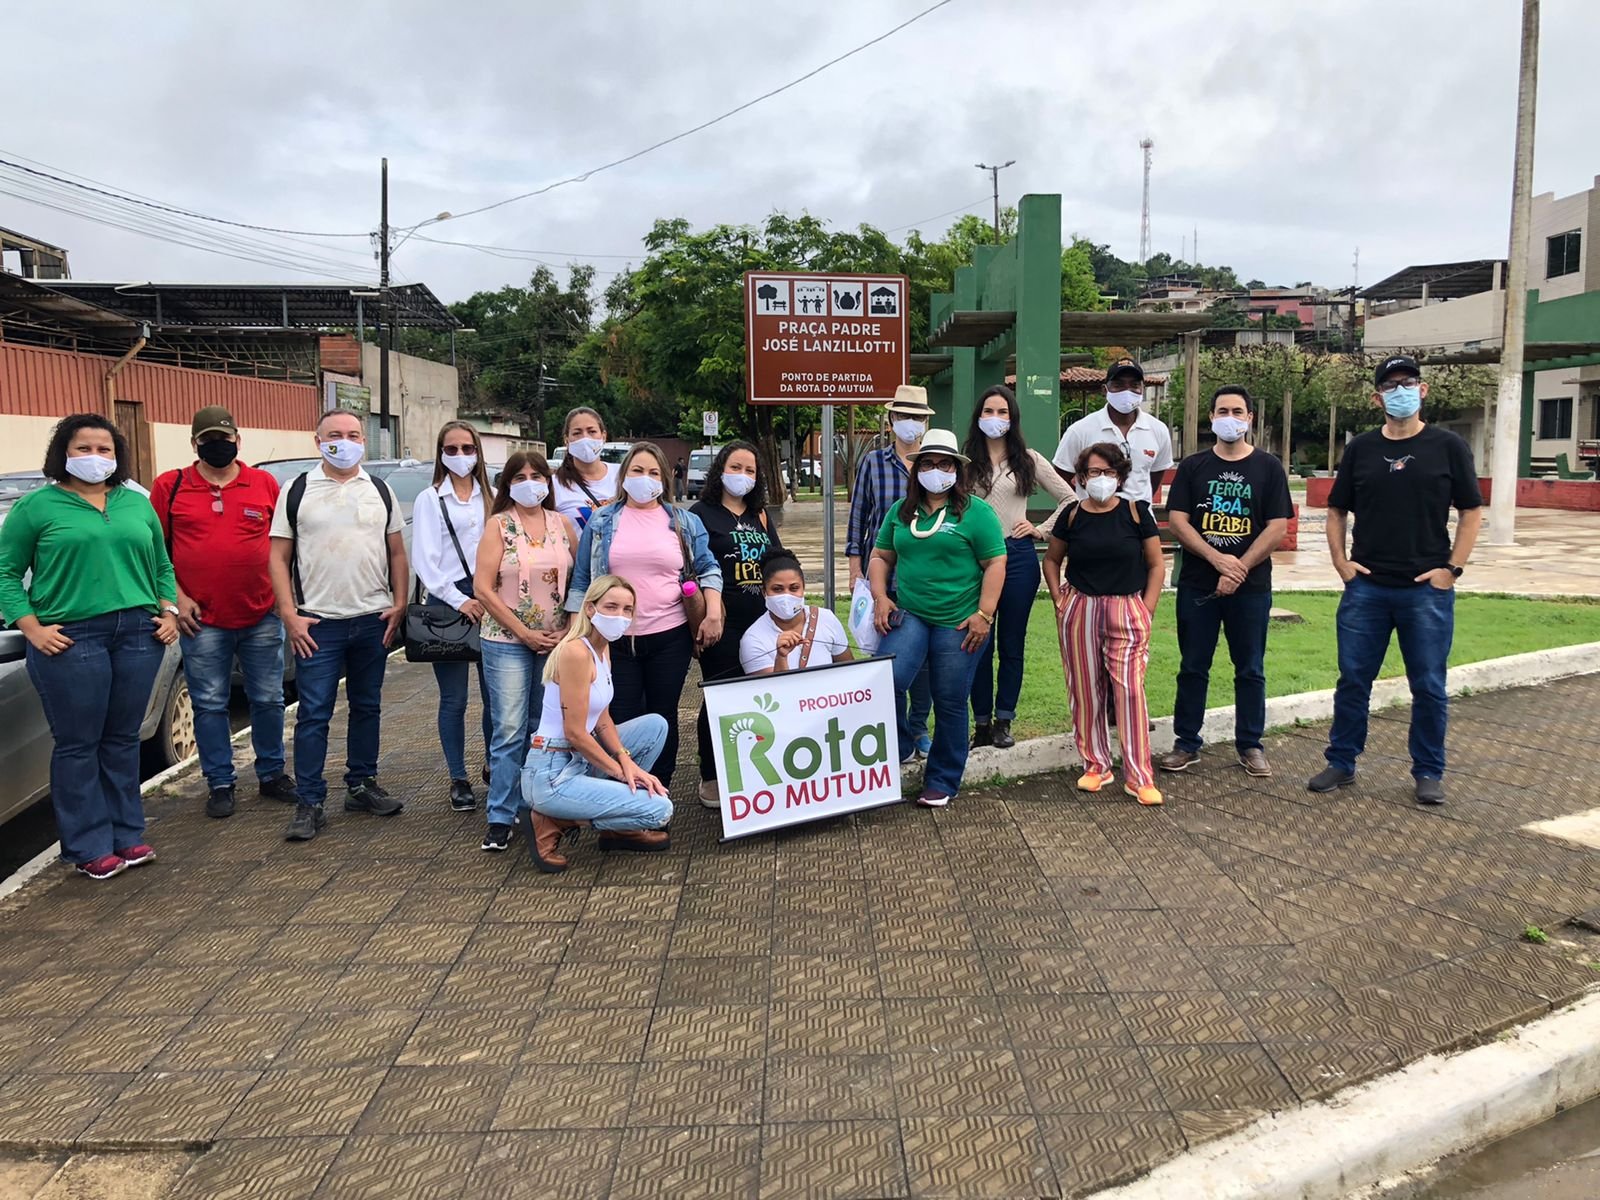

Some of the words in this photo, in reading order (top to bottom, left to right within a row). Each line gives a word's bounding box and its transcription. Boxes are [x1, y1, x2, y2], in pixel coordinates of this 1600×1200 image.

[779, 322, 827, 337] PRAÇA
[832, 323, 881, 336] PADRE
[762, 336, 798, 351] JOSÉ
[803, 339, 896, 353] LANZILLOTTI
[781, 373, 813, 382] PONTO
[816, 373, 829, 382] DE
[832, 373, 873, 382] PARTIDA
[780, 384, 793, 393] DA
[796, 384, 820, 393] ROTA
[823, 384, 836, 393] DO
[838, 384, 874, 393] MUTUM
[1208, 480, 1252, 499] TERRA
[1202, 512, 1251, 533] IPABA
[729, 531, 771, 544] TERRA
[735, 562, 763, 580] IPA
[799, 688, 872, 712] PRODUTOS
[719, 711, 888, 793] Rota
[729, 790, 775, 821] DO
[785, 764, 891, 808] MUTUM
